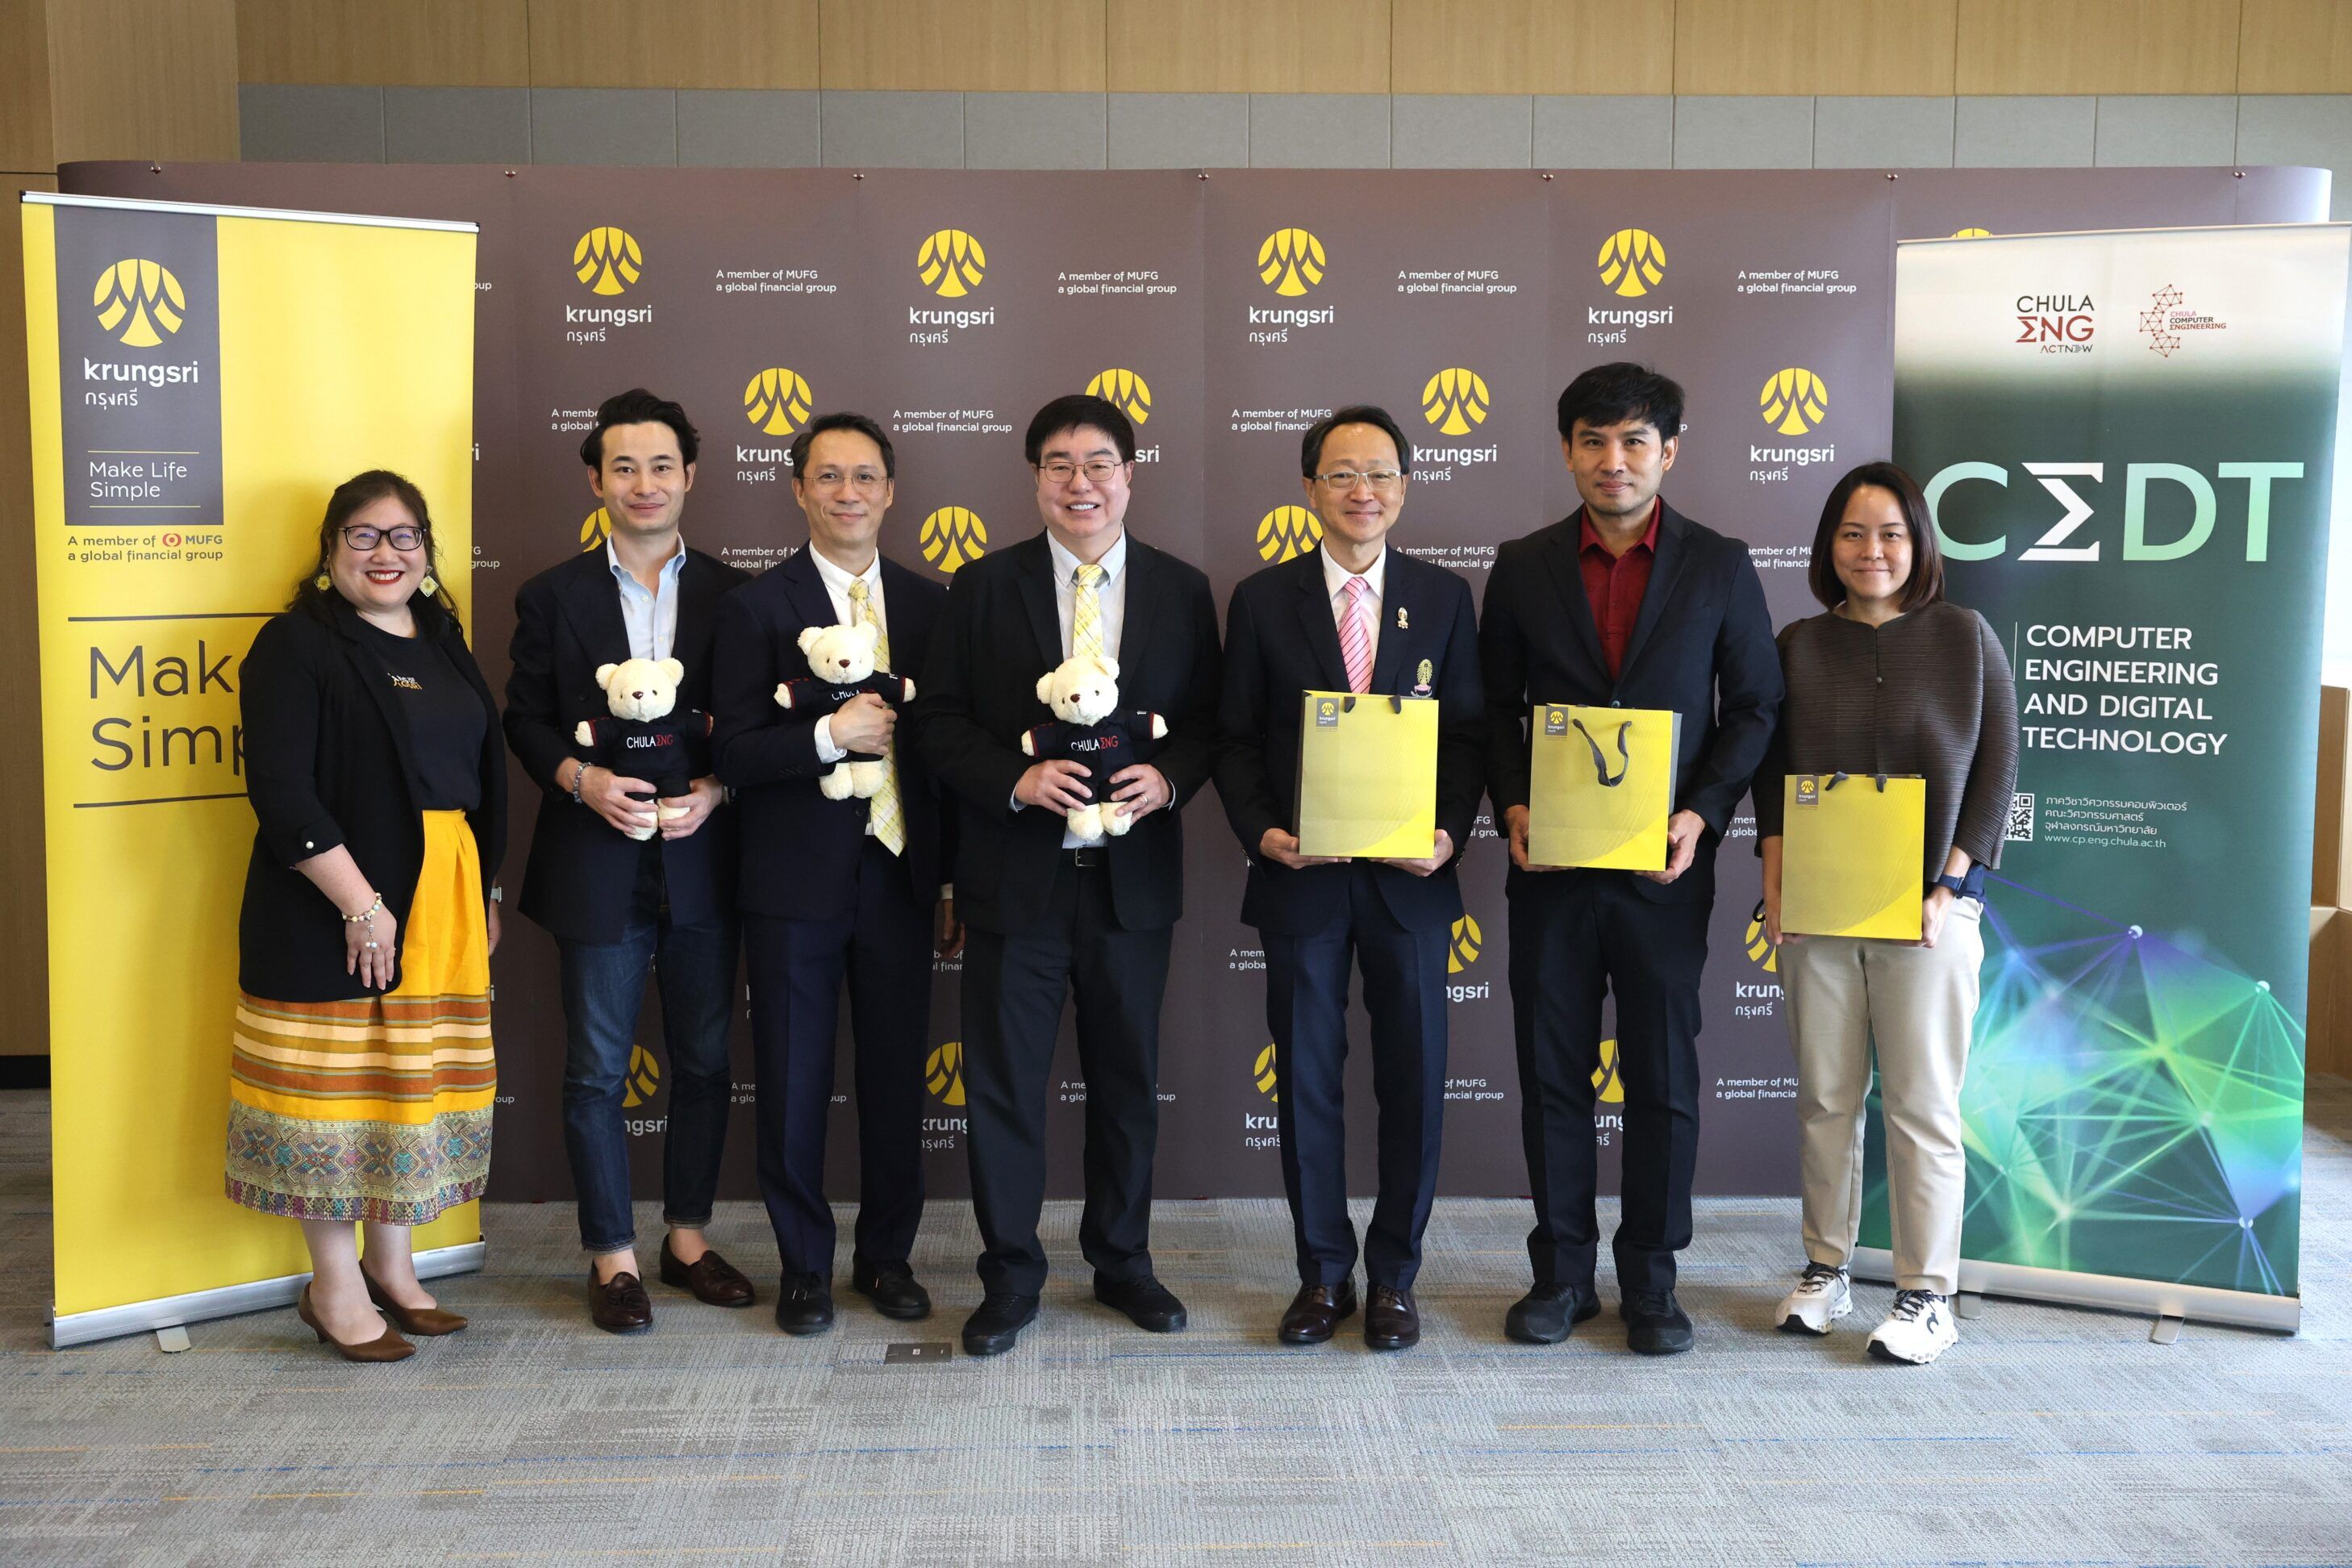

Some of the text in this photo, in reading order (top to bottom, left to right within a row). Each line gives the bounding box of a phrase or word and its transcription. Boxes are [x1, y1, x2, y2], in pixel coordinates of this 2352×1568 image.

[715, 269, 818, 281] A member of MUFG
[1057, 271, 1159, 282] A member of MUFG
[1398, 269, 1499, 281] A member of MUFG
[1737, 269, 1839, 281] A member of MUFG
[724, 281, 757, 294] global
[760, 281, 803, 294] financial
[806, 284, 837, 294] group
[1066, 284, 1099, 295] global
[1101, 283, 1144, 295] financial
[1146, 286, 1178, 295] group
[1406, 282, 1439, 294] global
[1441, 282, 1484, 294] financial
[1486, 285, 1517, 294] group
[1746, 282, 1779, 294] global
[1780, 282, 1824, 294] financial
[1826, 285, 1857, 294] group
[2016, 294, 2095, 313] CHULA
[566, 304, 652, 327] krungsri
[909, 306, 995, 328] krungsri
[1249, 305, 1334, 327] krungsri
[1588, 306, 1673, 328] krungsri
[2170, 316, 2214, 324] COMPUTER
[566, 327, 606, 344] กรุงศรี
[909, 328, 949, 346] กรุงศรี
[1249, 327, 1288, 345] กรุงศรี
[1587, 328, 1627, 346] กรุงศรี
[84, 357, 198, 387] krungsri
[85, 387, 139, 410] กรุงศรี
[551, 408, 560, 418] A
[893, 409, 994, 421] A member of MUFG
[1232, 408, 1332, 420] A member of MUFG
[560, 420, 593, 432] global
[893, 422, 1012, 433] a global financial group
[1240, 421, 1272, 432] global
[736, 444, 794, 468] krung
[1413, 444, 1497, 466] krungsri
[1750, 444, 1835, 466] krungsri
[90, 461, 188, 481] Make Life
[736, 466, 776, 484] กรุงศรี
[1412, 466, 1451, 484] กรุงศรี
[1749, 466, 1789, 484] กรุงศรี
[90, 481, 161, 501] Simple
[68, 534, 223, 548] A member of MUFG
[68, 549, 223, 563] a global financial group
[721, 547, 729, 556] A
[732, 546, 775, 556] member
[777, 547, 788, 558] of
[1406, 546, 1449, 556] member
[1450, 546, 1462, 557] of
[1463, 546, 1495, 556] MUFG
[1786, 545, 1797, 557] of
[1437, 558, 1480, 569] financial
[2025, 624, 2192, 650] COMPUTER
[90, 640, 242, 700] Mak
[2025, 658, 2219, 686] ENGINEERING
[2024, 692, 2213, 720] AND DIGITAL
[2022, 726, 2229, 755] TECHNOLOGY
[2045, 796, 2188, 812] ภาควิชาวิศวกรรมคอมพิวเตอร์
[2045, 808, 2145, 823] คณะวิศวกรรมศาสตร์
[2045, 821, 2158, 836] จุฬาลงกรณ์มหาวิทยาลัย
[2044, 834, 2167, 849] www.cp.eng.chula.ac.th
[1229, 949, 1238, 957] A
[1238, 960, 1266, 971] globa
[1736, 981, 1784, 1001] krun
[1735, 1001, 1773, 1020] กรุงศรี
[732, 1082, 739, 1091] A
[1060, 1081, 1069, 1089] A
[1456, 1078, 1487, 1087] MUFG
[1716, 1077, 1799, 1089] A member of MU
[739, 1094, 756, 1104] glo
[1157, 1094, 1176, 1103] oup
[1444, 1090, 1504, 1102] ancial group
[1716, 1089, 1797, 1100] a global financia
[494, 1097, 515, 1107] oup
